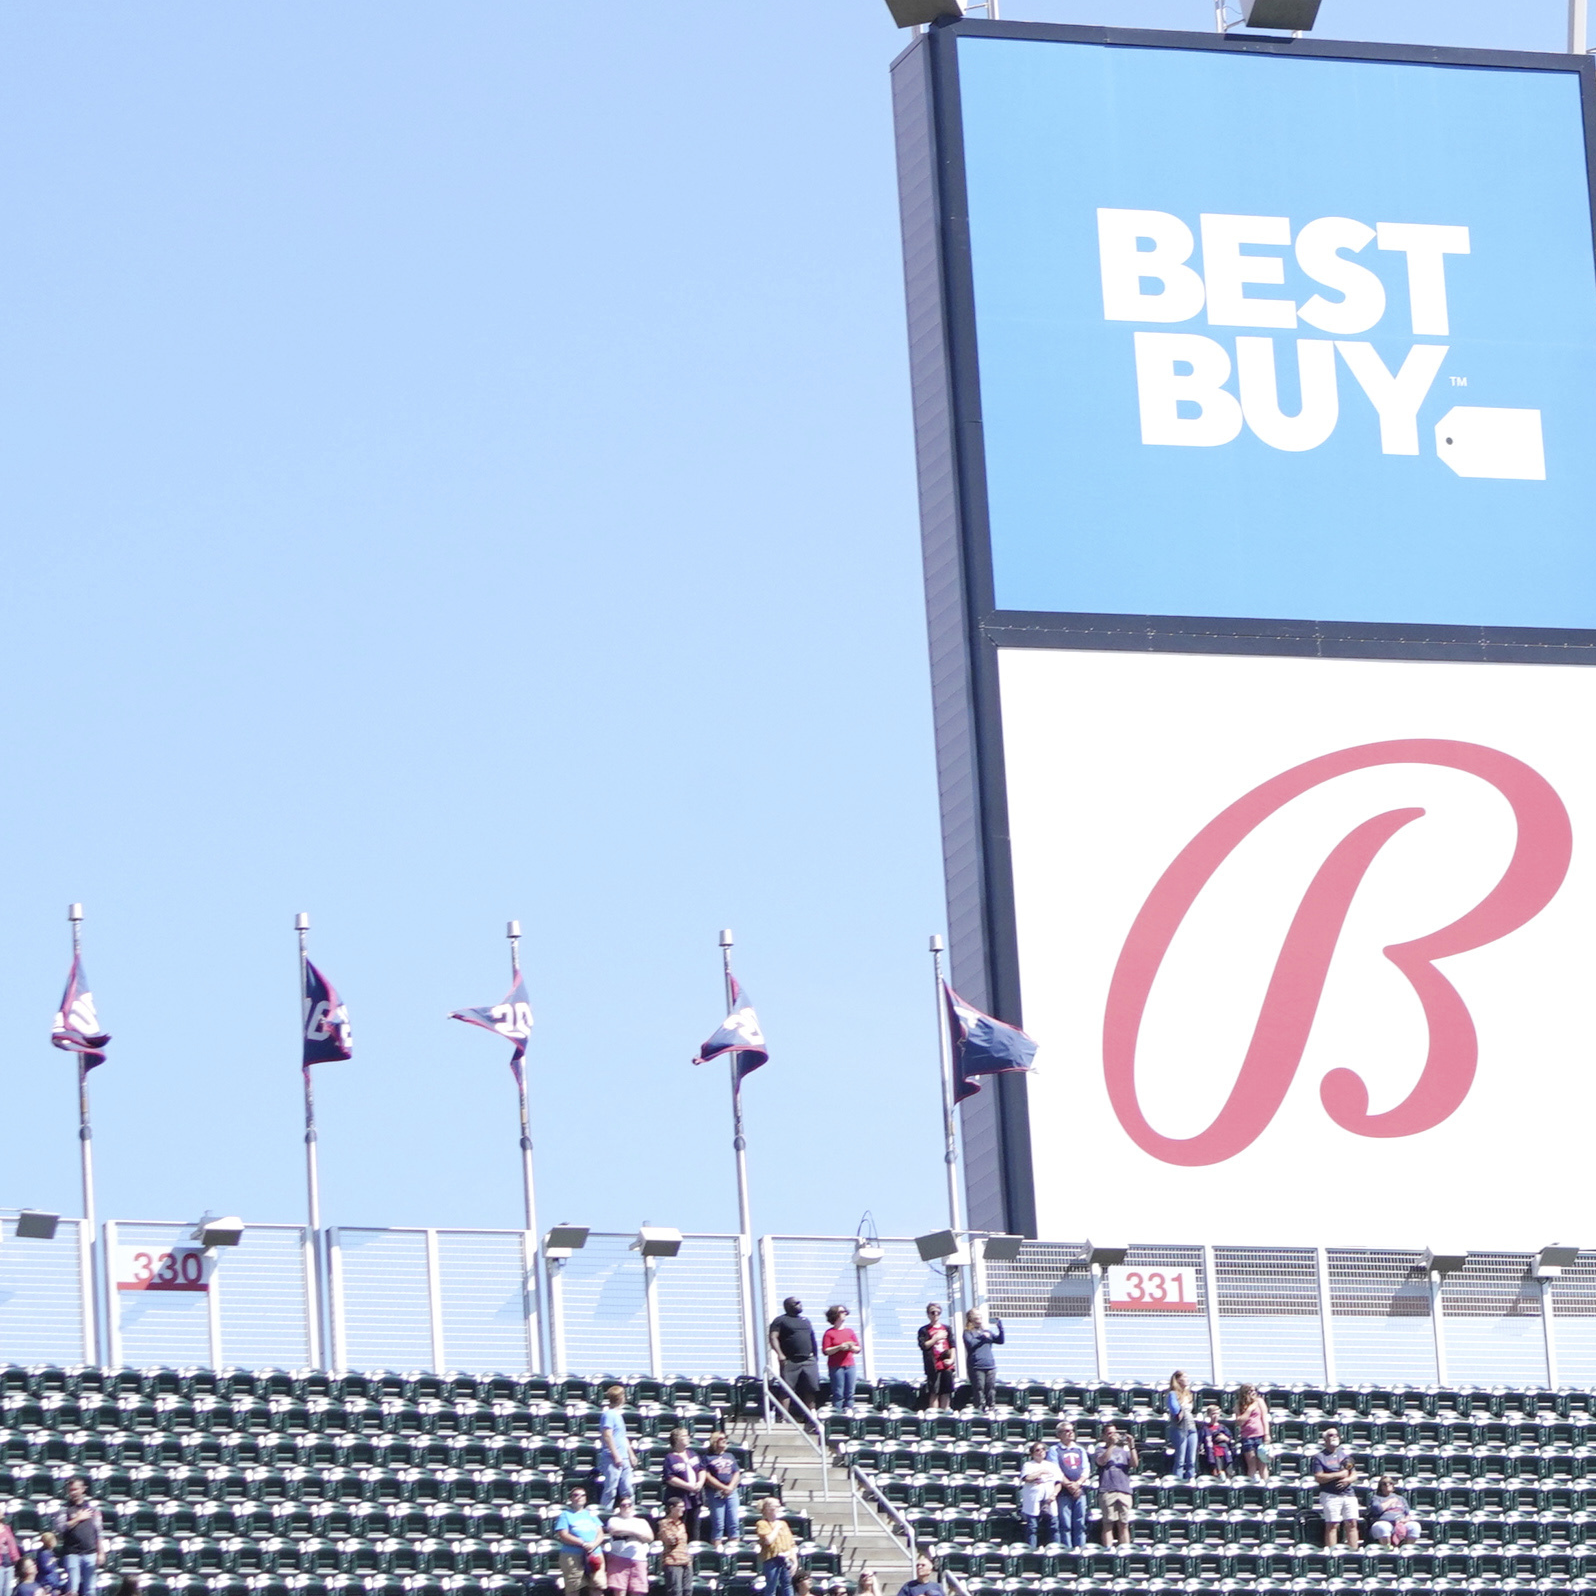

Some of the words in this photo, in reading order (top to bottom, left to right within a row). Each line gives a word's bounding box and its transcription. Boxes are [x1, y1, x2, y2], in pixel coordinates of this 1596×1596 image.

[1096, 207, 1471, 336] BEST
[1133, 331, 1451, 457] BUY
[133, 1252, 204, 1286] 330
[1124, 1271, 1190, 1304] 331
